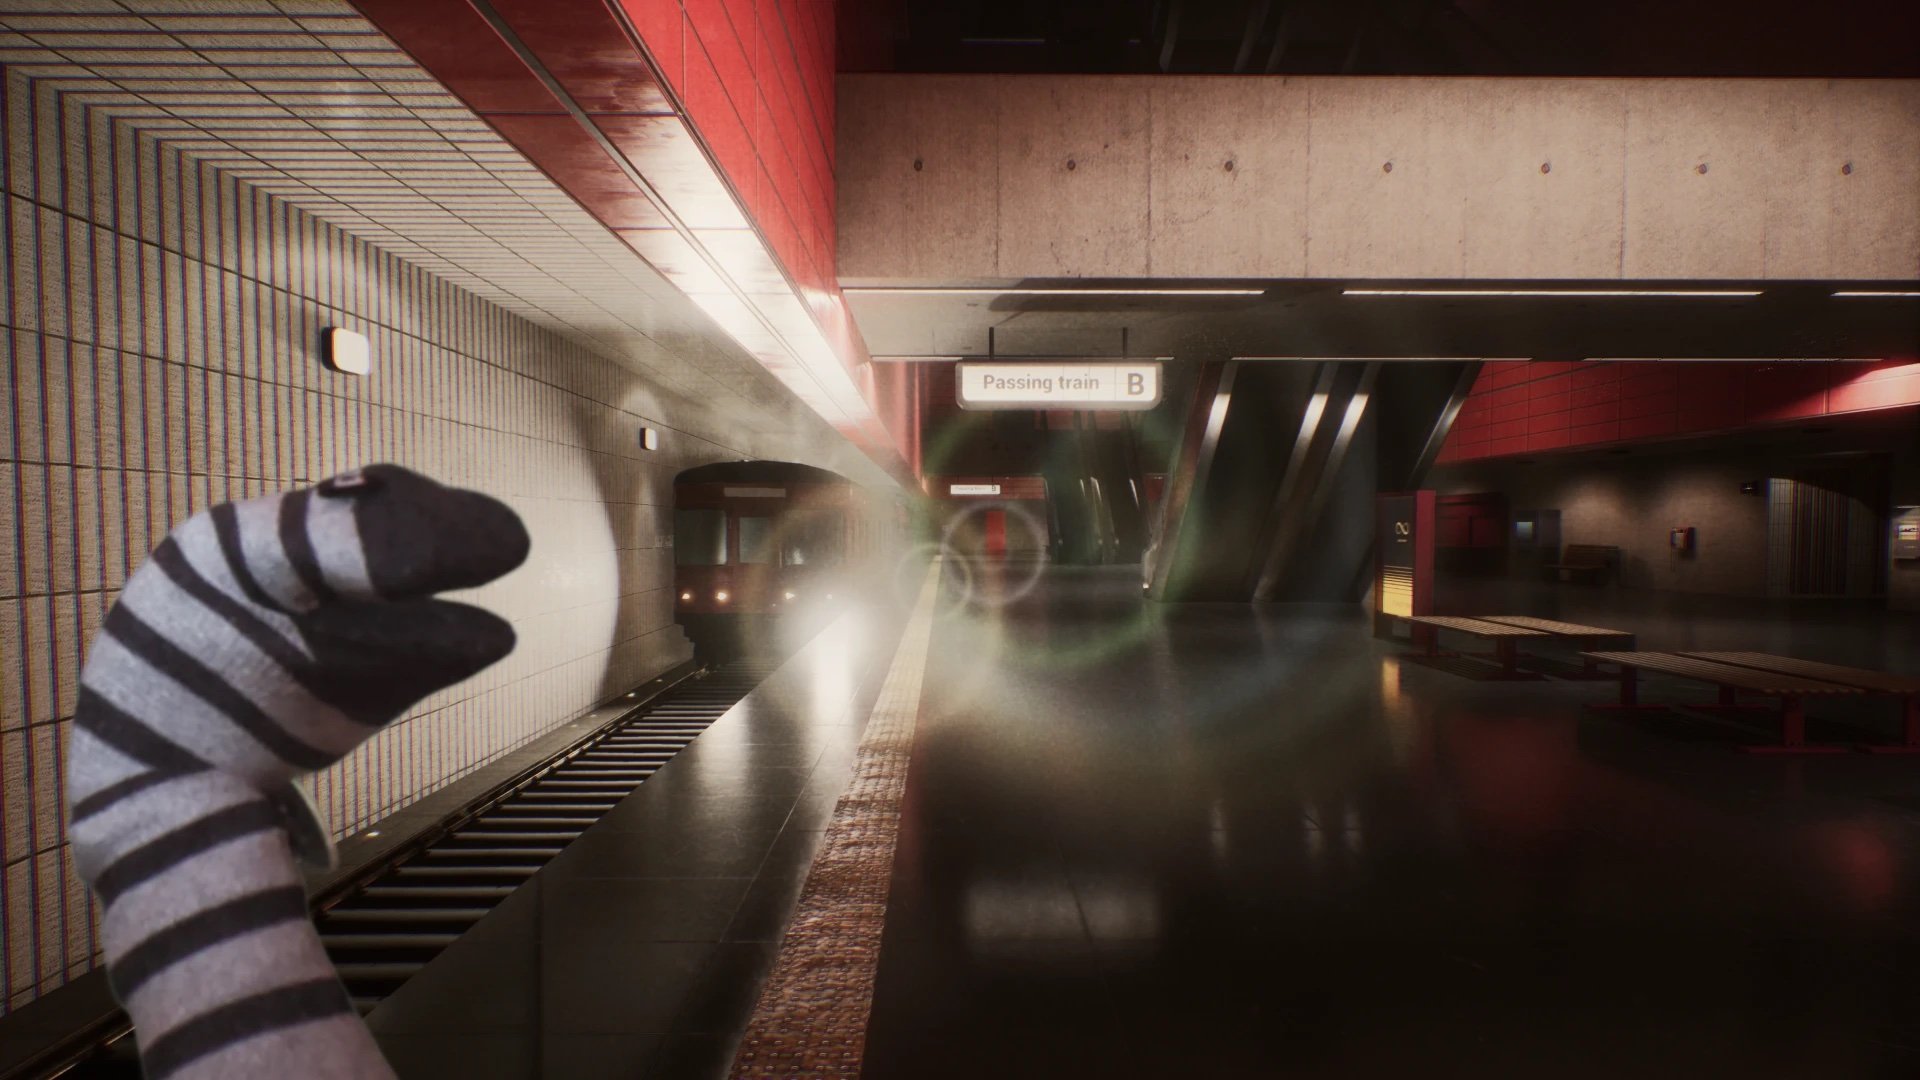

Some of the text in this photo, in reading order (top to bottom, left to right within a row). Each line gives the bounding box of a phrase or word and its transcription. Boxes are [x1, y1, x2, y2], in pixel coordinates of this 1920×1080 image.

[983, 373, 1144, 395] Passing train B
